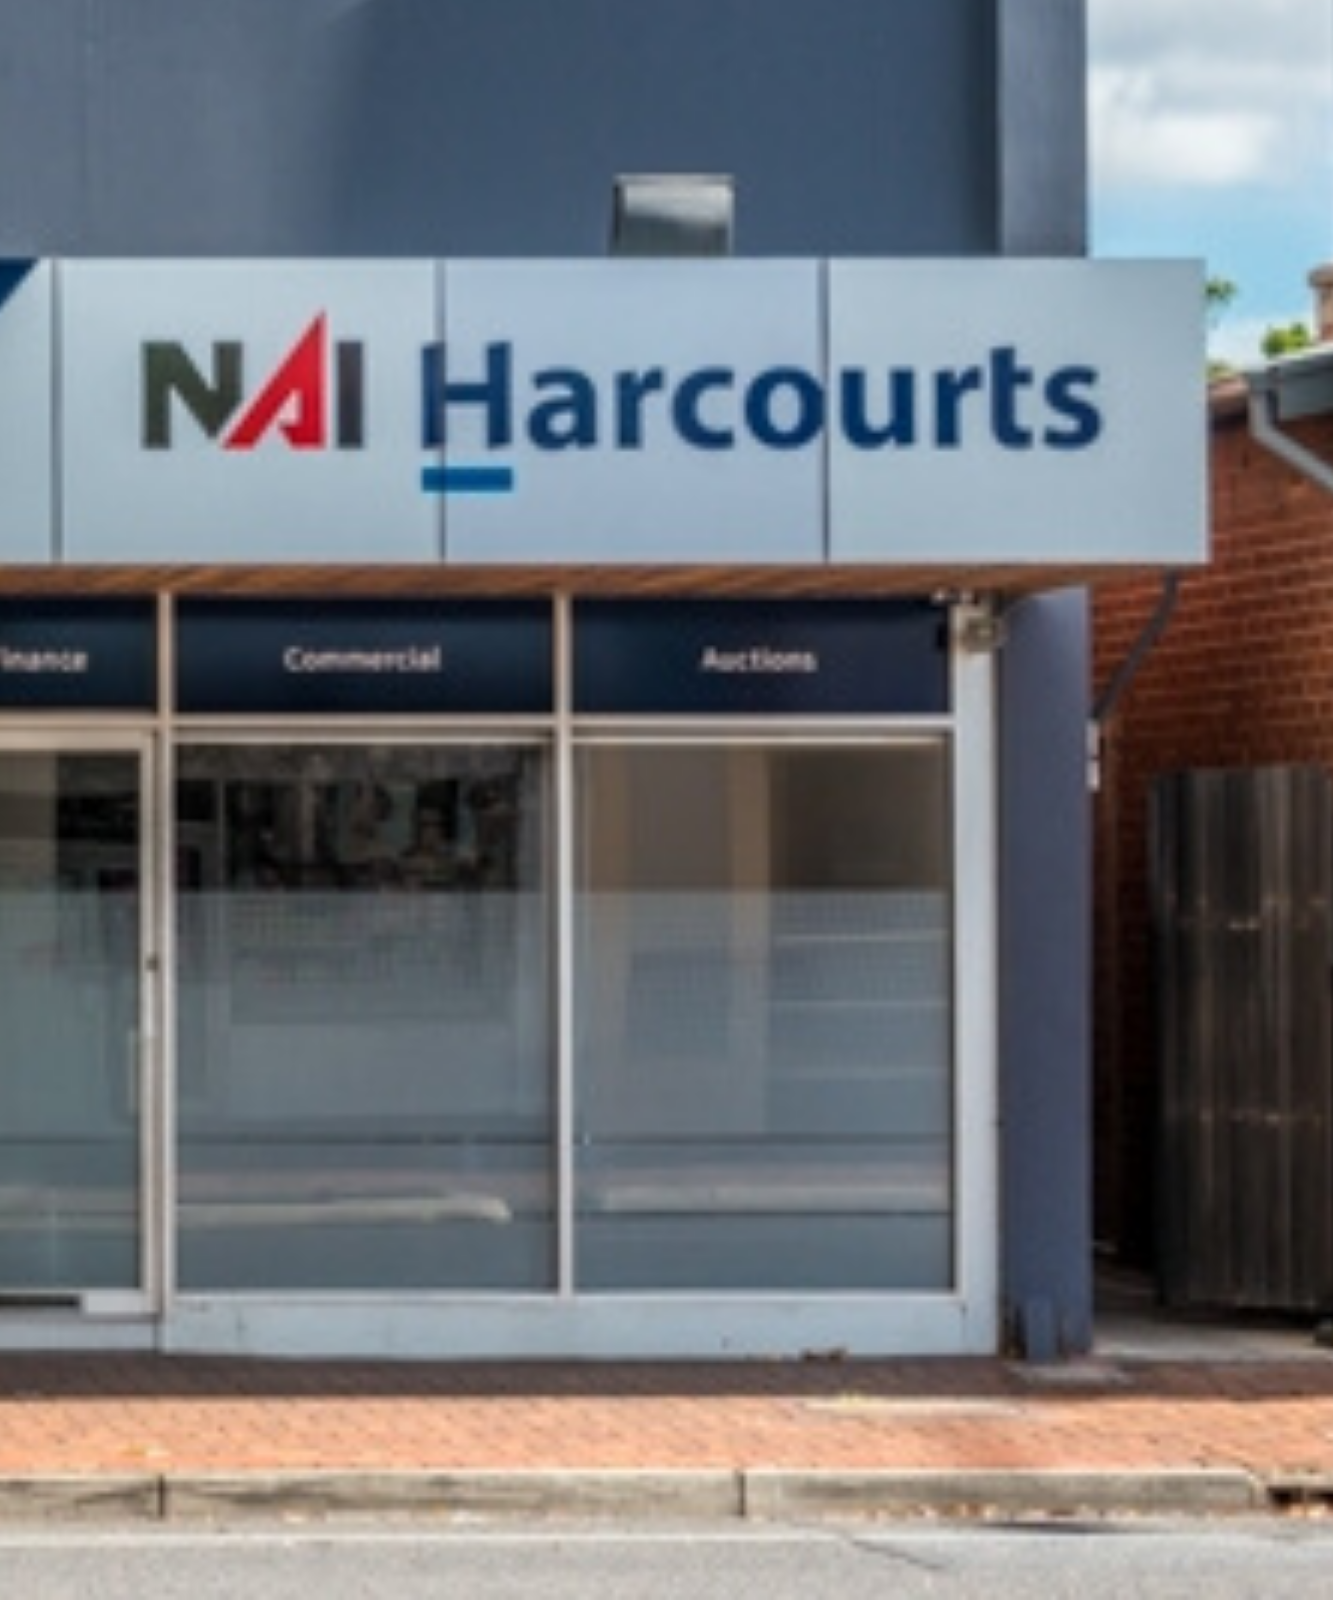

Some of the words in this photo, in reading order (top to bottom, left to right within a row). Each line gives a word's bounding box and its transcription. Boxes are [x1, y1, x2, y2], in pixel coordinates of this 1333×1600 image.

[140, 309, 365, 451] NAI
[420, 340, 1104, 452] Harcourts
[283, 646, 442, 673] Commercial
[700, 646, 817, 674] Auctions
